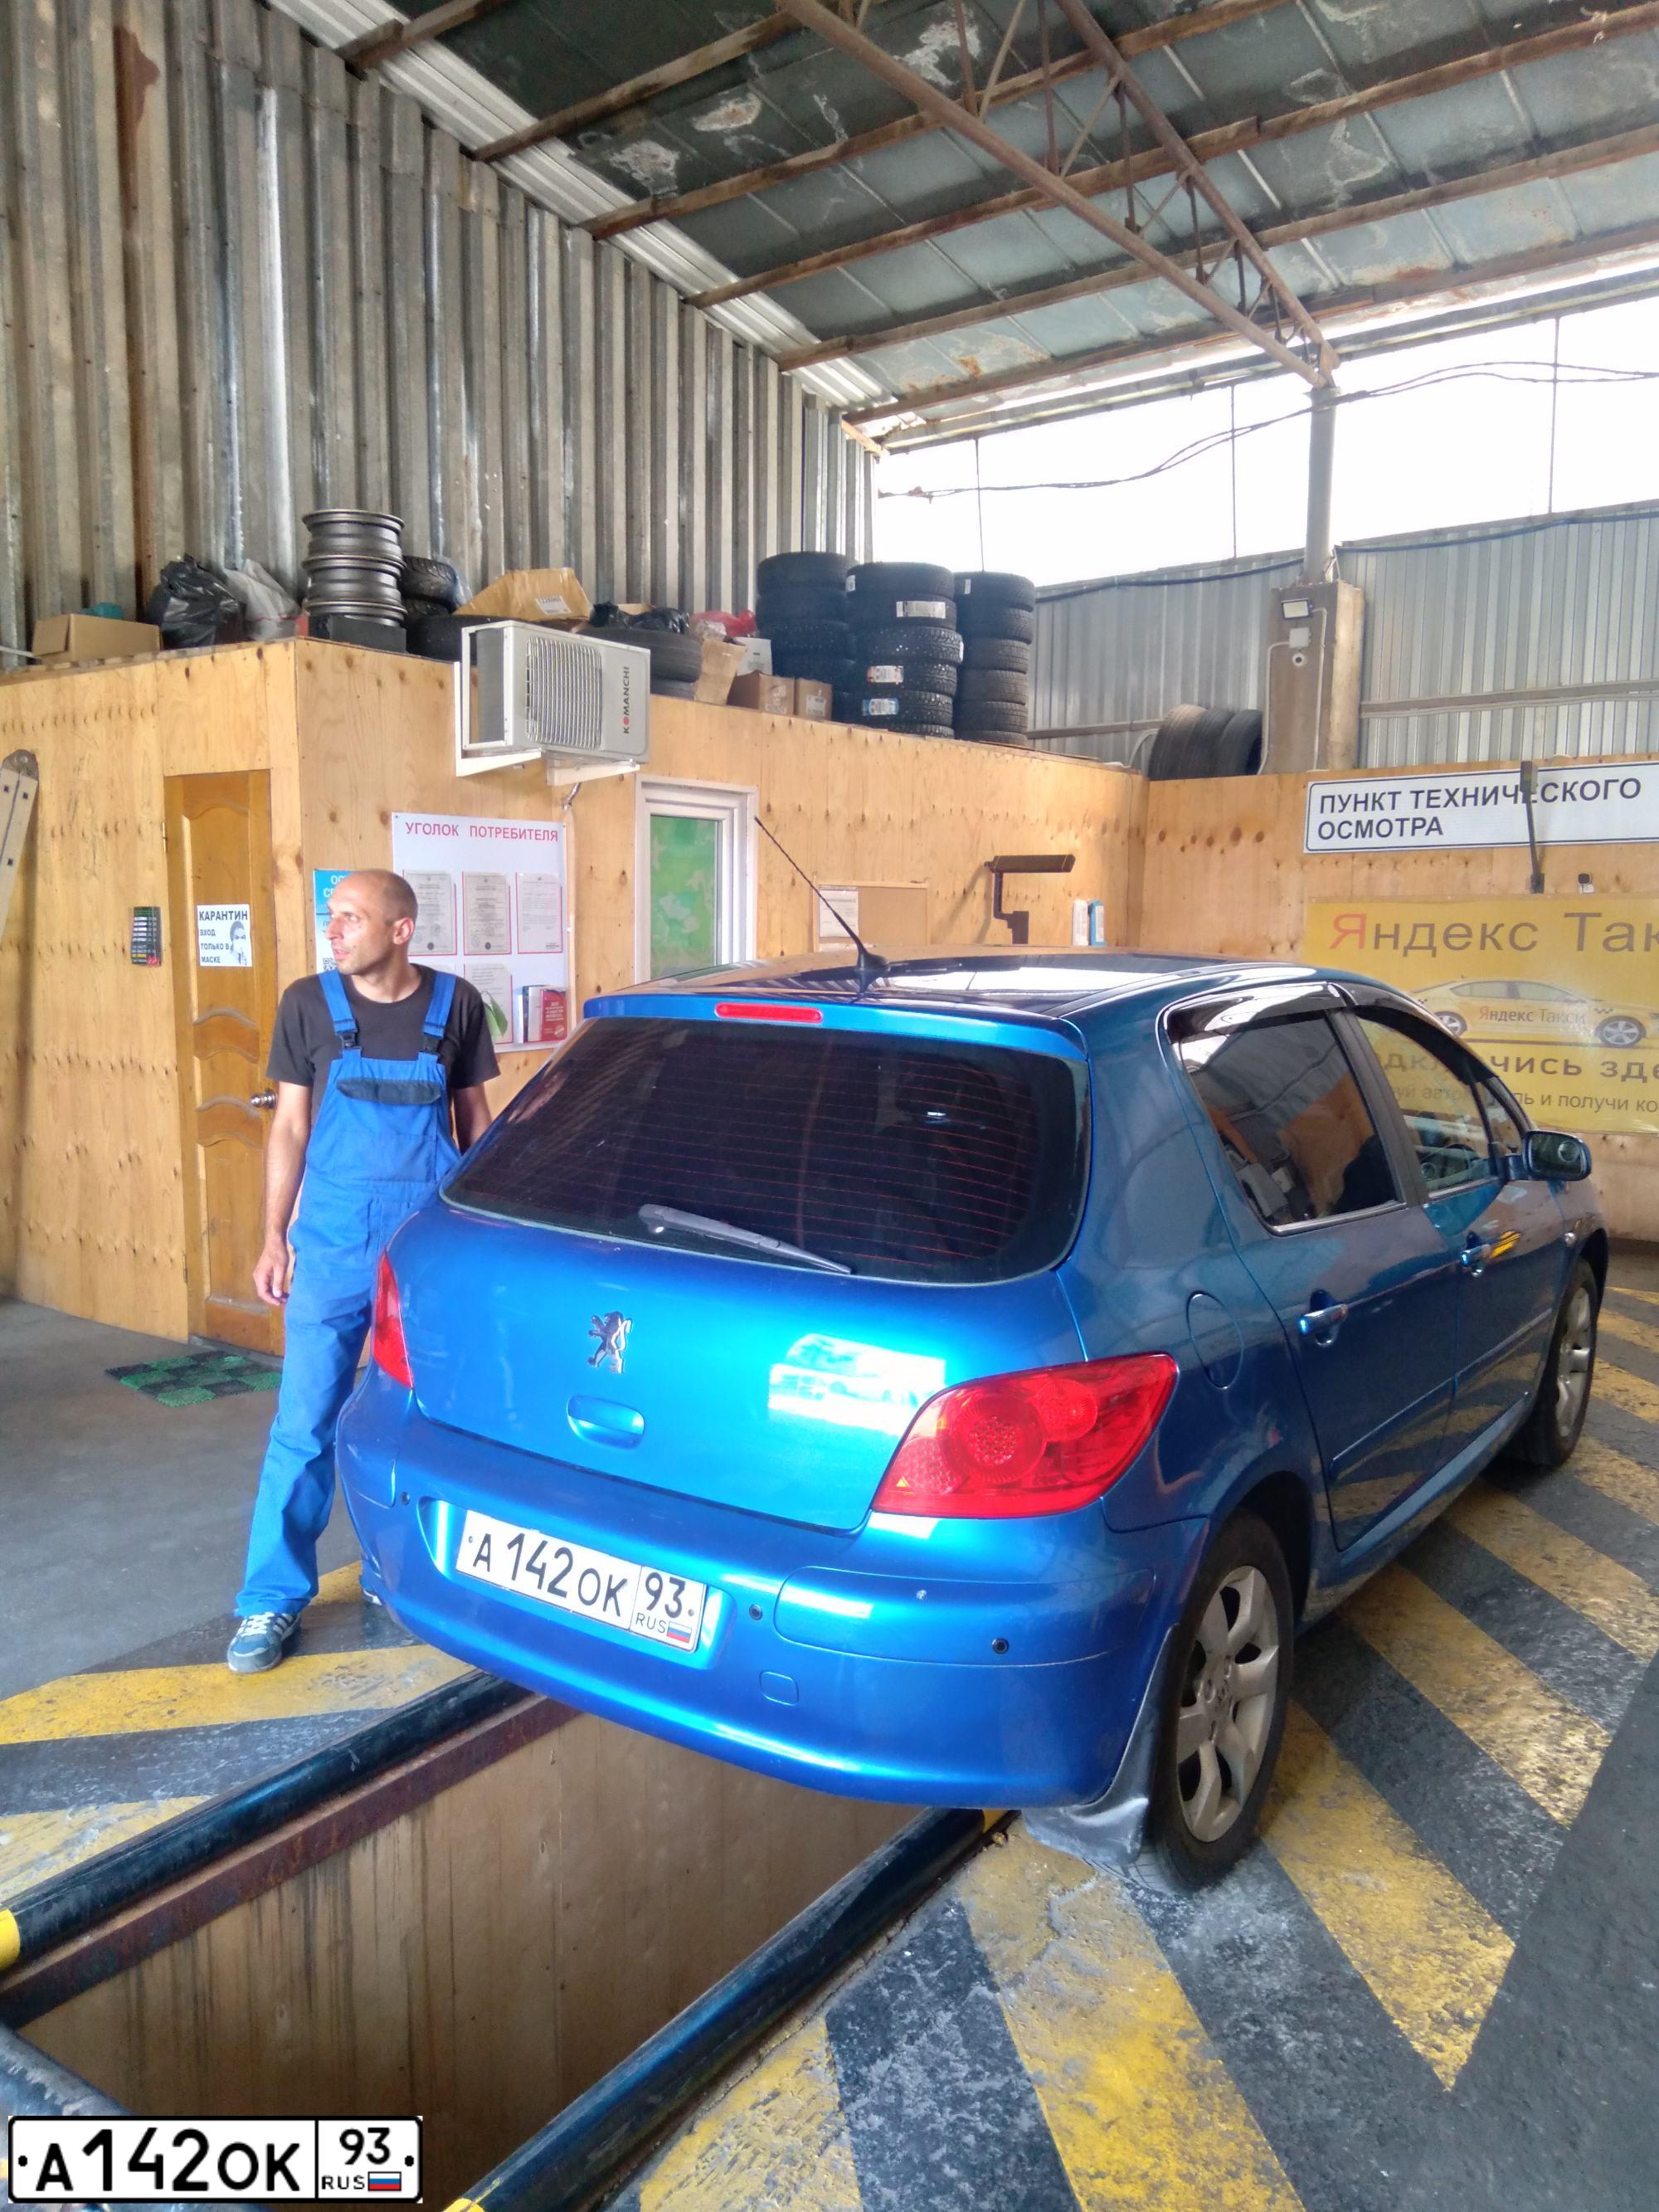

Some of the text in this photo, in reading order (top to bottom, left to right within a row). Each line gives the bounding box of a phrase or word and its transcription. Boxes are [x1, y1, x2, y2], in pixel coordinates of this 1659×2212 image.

[1320, 777, 1642, 814] ПУНКТ ТЕХНИЧСКОГО
[405, 821, 558, 841] УГОЛОК ПОТРЕБИТЕЛЯ
[1317, 816, 1443, 840] ОСМОТРА
[199, 911, 248, 921] КАРАНТИН
[1330, 913, 1539, 957] Яндекс
[1478, 1006, 1534, 1022] Яндекс
[1540, 1094, 1551, 1106] и
[1558, 1094, 1628, 1113] получи
[645, 1571, 686, 1619] 93
[635, 1612, 667, 1634] RUS
